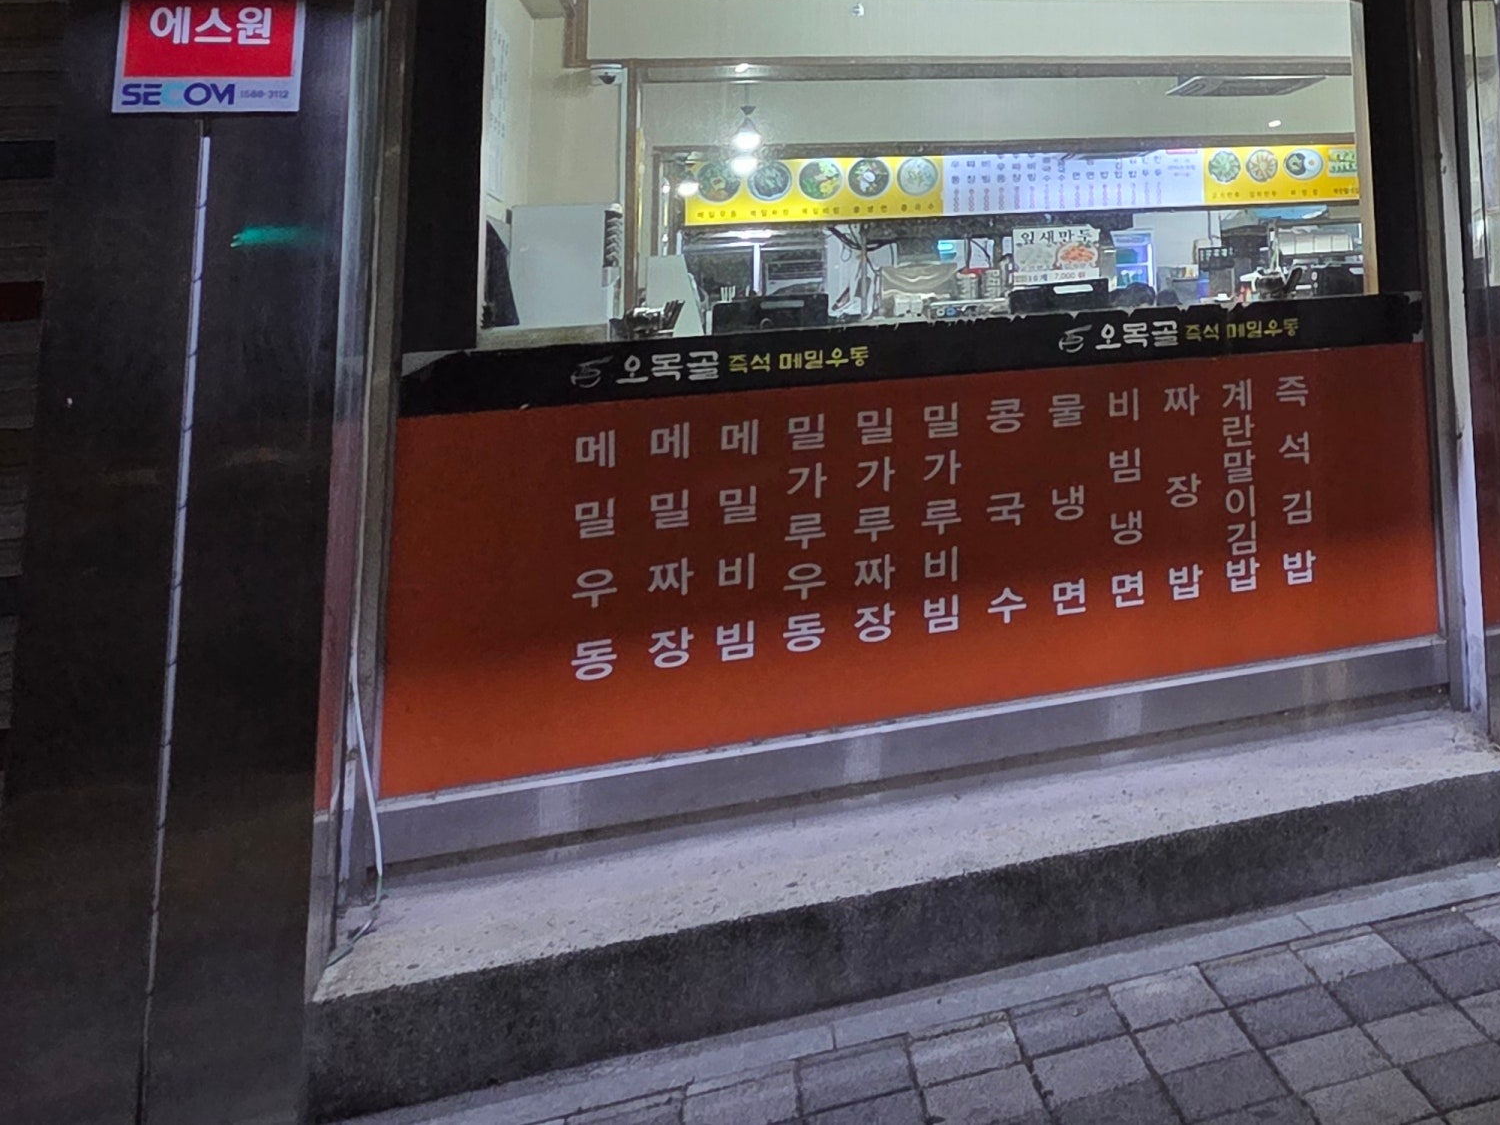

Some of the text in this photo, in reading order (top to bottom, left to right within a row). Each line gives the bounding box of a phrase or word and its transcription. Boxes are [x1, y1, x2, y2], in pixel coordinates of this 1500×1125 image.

[150, 6, 272, 46] 에스원
[121, 83, 236, 106] SECOM
[1095, 317, 1299, 351] 오목골 즉석 메밀우동
[615, 345, 870, 385] 오목골 즉석 메밀우동
